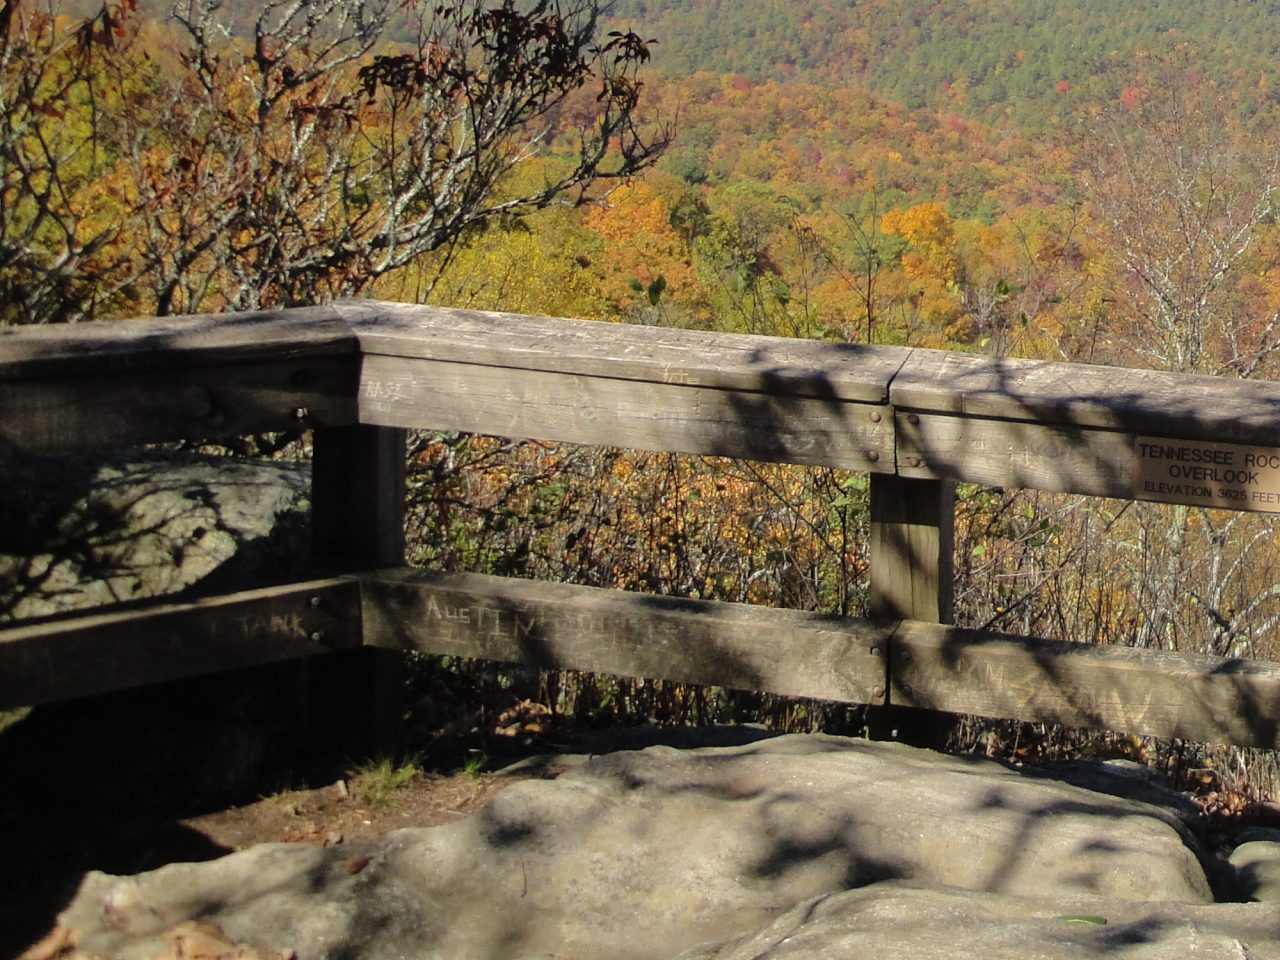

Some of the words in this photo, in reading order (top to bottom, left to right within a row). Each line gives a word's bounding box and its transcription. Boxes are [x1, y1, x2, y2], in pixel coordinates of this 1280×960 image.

[1139, 443, 1234, 466] TENNESSEE
[1168, 464, 1259, 486] OVERLOOK
[1144, 481, 1212, 498] ELEVATION
